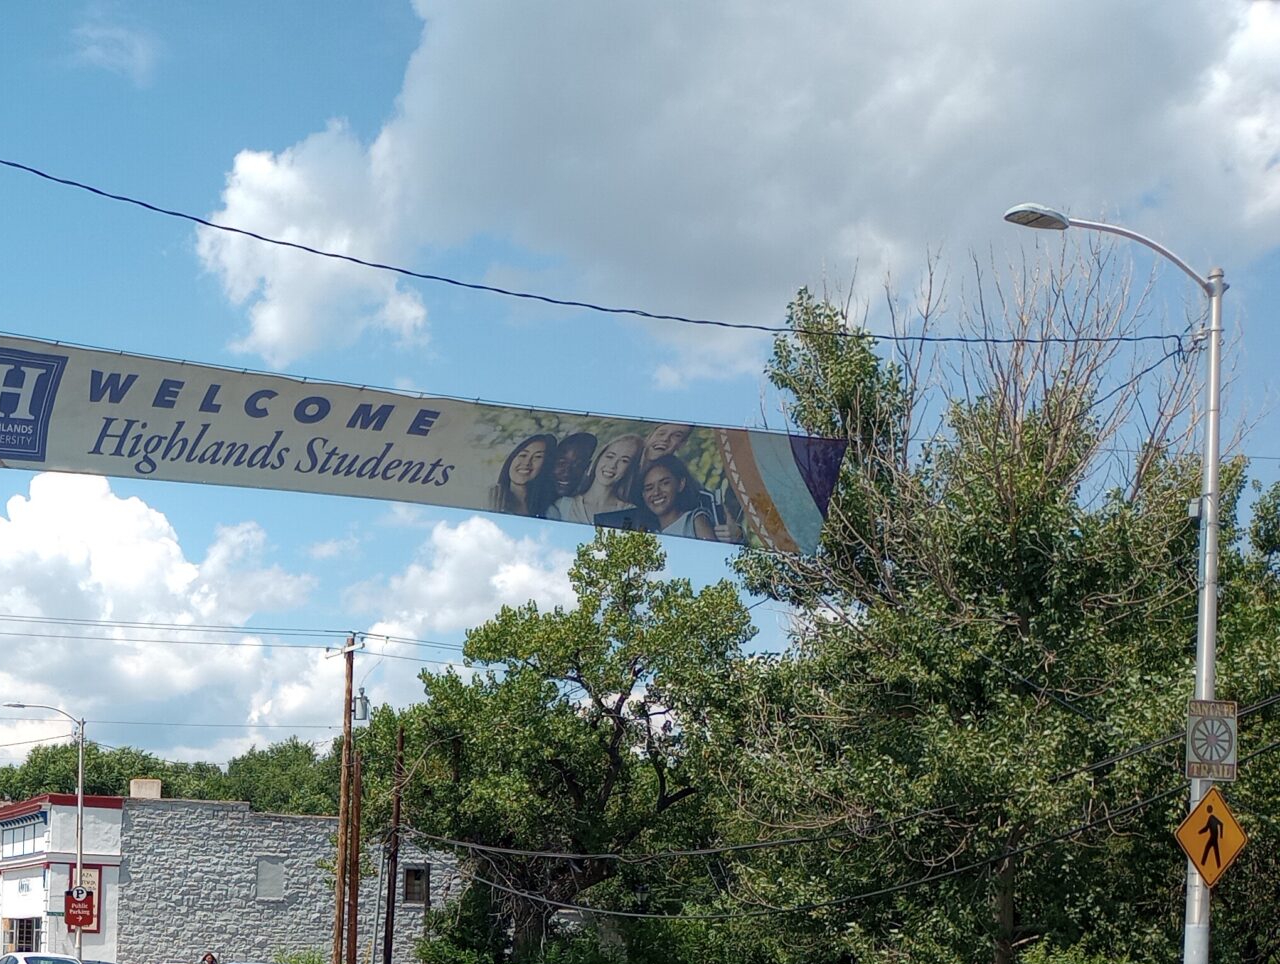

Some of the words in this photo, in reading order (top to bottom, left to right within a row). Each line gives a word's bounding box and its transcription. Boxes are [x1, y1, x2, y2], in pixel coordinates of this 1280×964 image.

[89, 369, 440, 437] WELCOME
[88, 416, 290, 475] Highlands
[294, 436, 455, 487] Students
[1190, 702, 1221, 717] SANTA
[1223, 704, 1235, 717] FE
[1190, 763, 1233, 778] TRAIL
[76, 889, 85, 899] P
